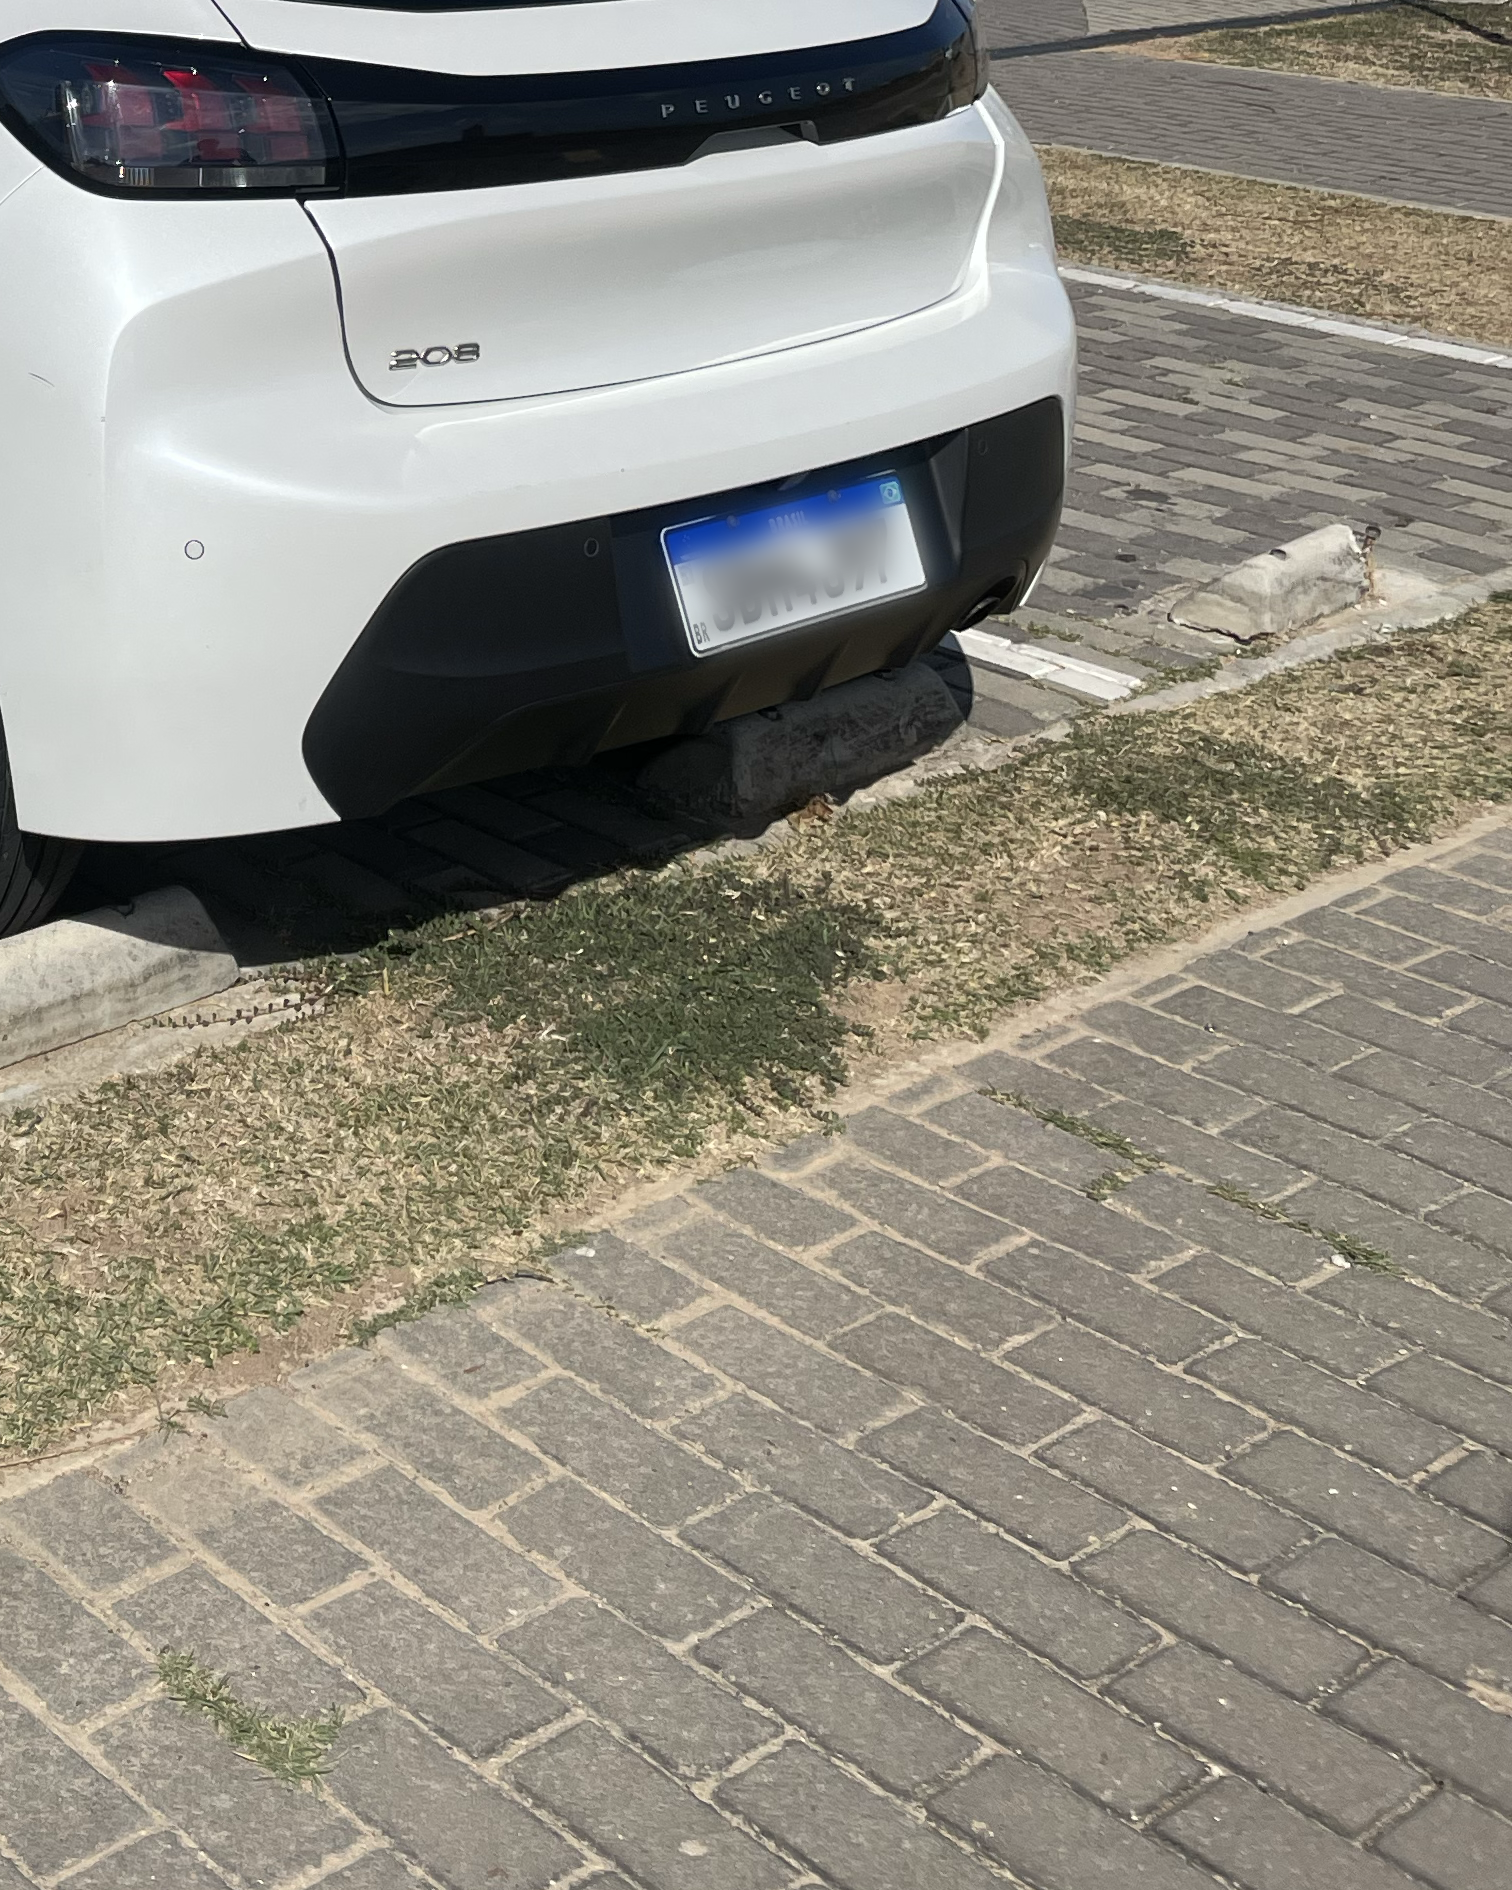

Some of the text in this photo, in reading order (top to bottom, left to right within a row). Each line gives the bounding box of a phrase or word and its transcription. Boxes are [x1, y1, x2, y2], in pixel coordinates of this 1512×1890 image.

[660, 77, 856, 119] PEUGEOT
[388, 342, 480, 371] 208
[692, 621, 711, 645] BR
